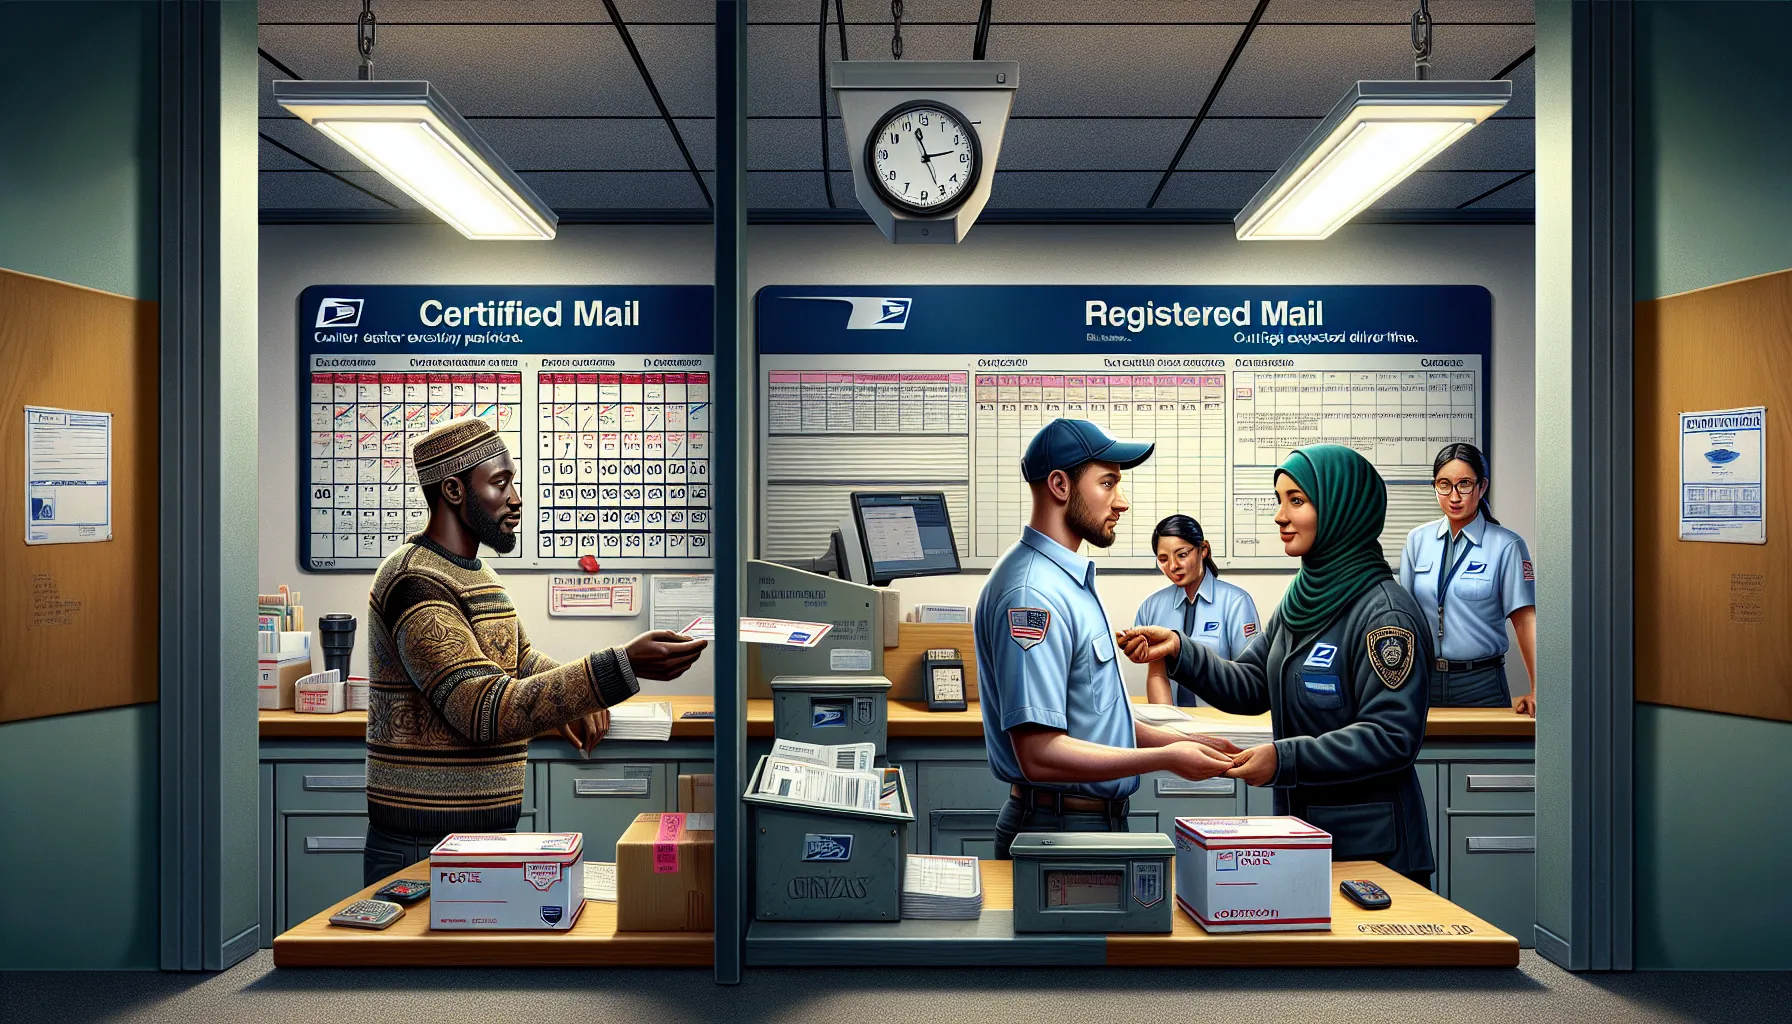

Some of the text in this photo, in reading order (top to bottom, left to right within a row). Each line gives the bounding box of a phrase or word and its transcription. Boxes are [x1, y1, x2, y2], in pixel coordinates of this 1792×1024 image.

[573, 300, 640, 326] Mail
[1085, 300, 1323, 333] Registered Mail
